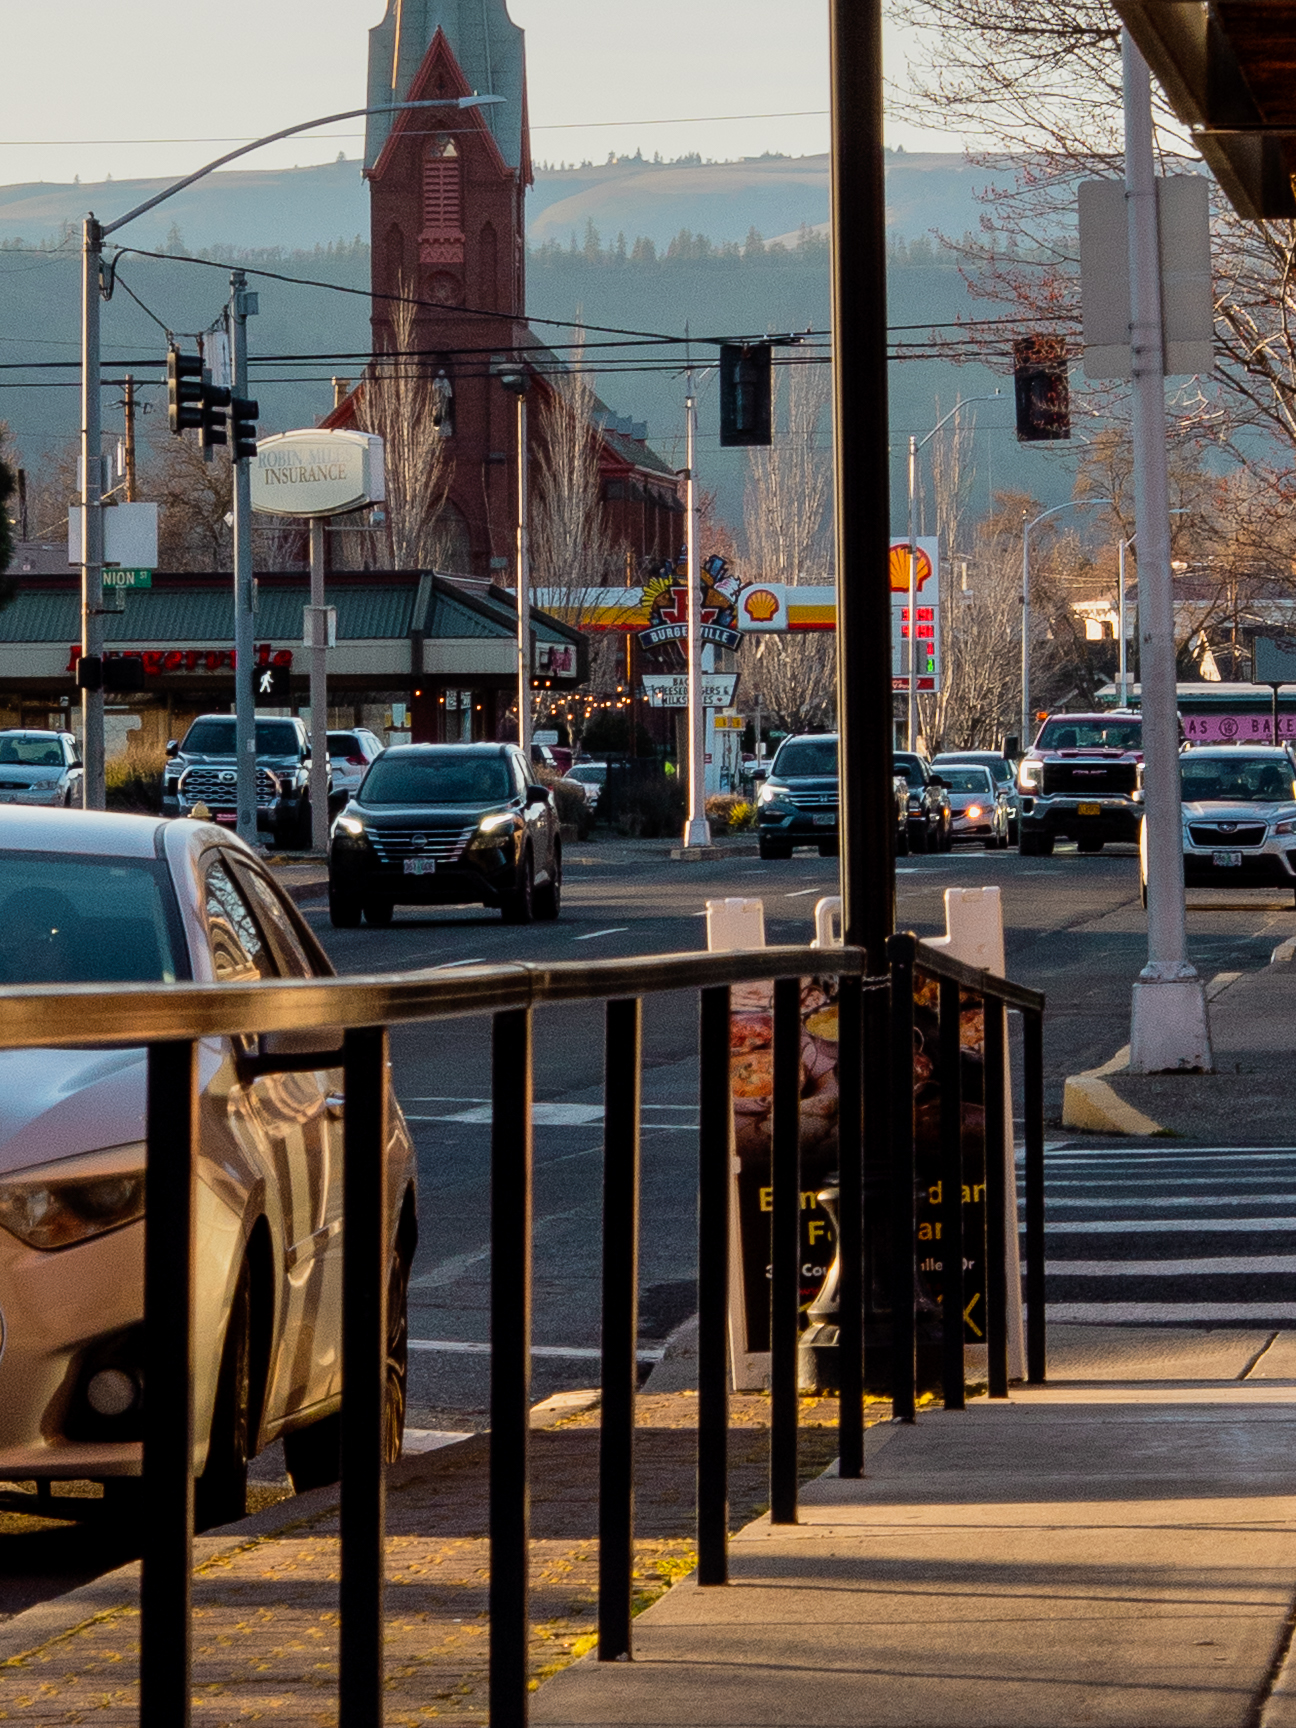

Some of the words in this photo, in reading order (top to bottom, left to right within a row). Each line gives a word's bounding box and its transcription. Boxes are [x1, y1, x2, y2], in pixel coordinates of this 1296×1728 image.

[258, 449, 304, 468] ROBIN
[265, 463, 346, 485] INSURANCE
[103, 571, 135, 585] NION
[1188, 719, 1207, 734] AS
